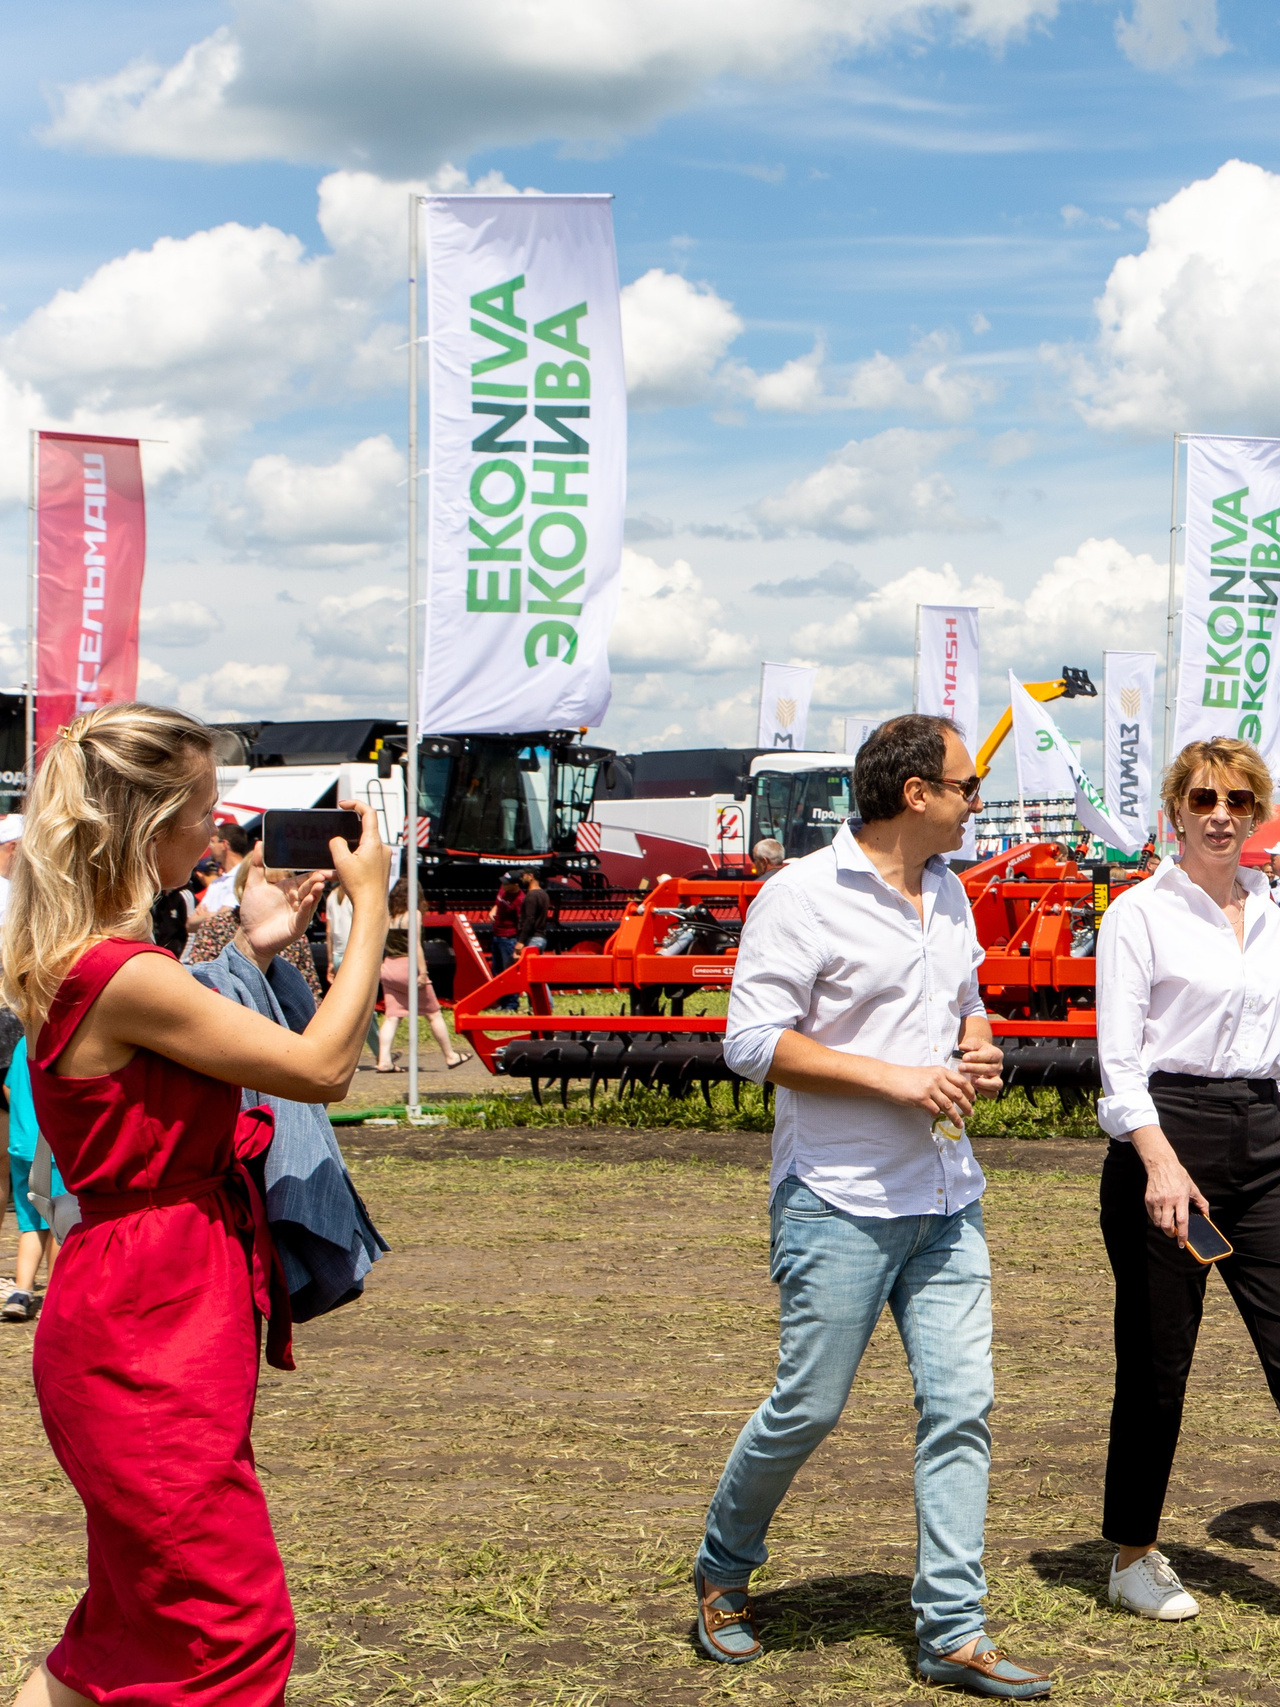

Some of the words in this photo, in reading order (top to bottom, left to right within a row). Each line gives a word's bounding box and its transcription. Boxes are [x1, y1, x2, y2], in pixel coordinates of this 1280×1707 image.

[466, 273, 528, 613] EKONIVA
[524, 301, 591, 668] ЭКОНИВА
[1201, 486, 1249, 709] EKONIVA
[1120, 723, 1140, 818] АЛМАЗ
